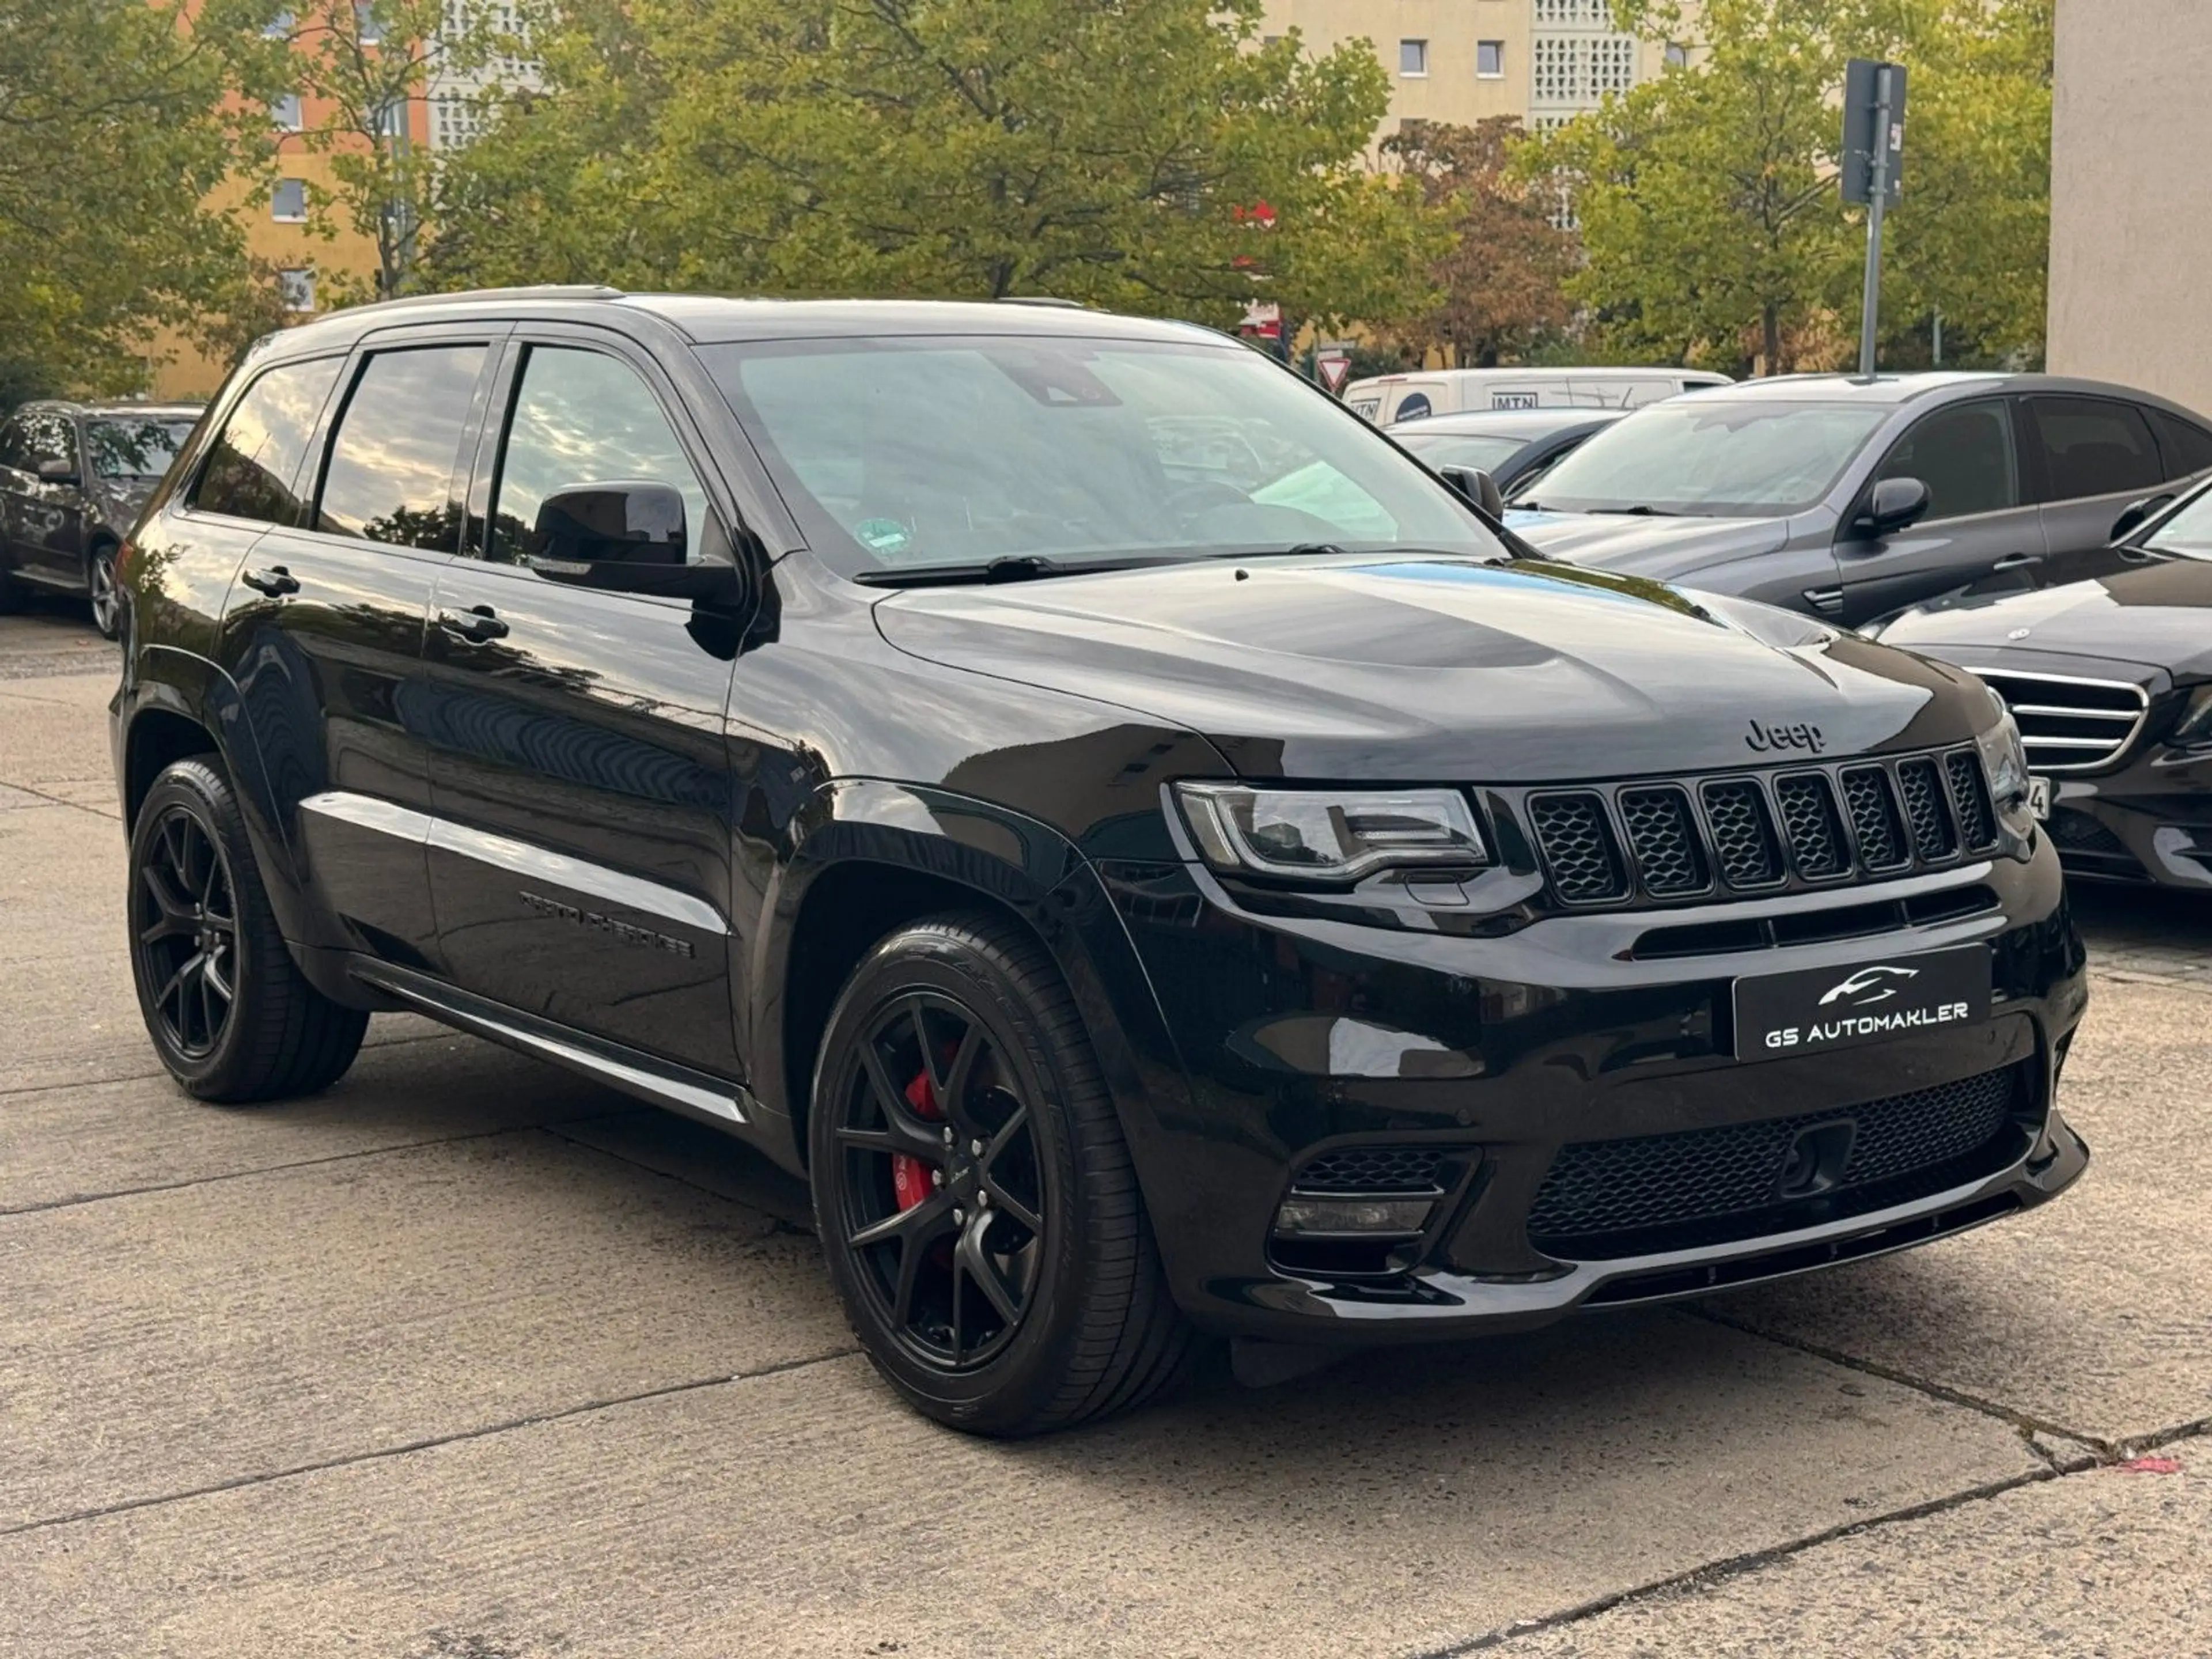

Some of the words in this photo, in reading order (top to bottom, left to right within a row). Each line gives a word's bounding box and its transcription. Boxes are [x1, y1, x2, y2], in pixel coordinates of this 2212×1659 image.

[1498, 397, 1533, 410] MTN
[1745, 719, 1825, 753] Jeep
[2031, 785, 2044, 813] 4
[1765, 1028, 1800, 1048] GS
[1806, 1002, 1968, 1043] AUTOMAKLER
